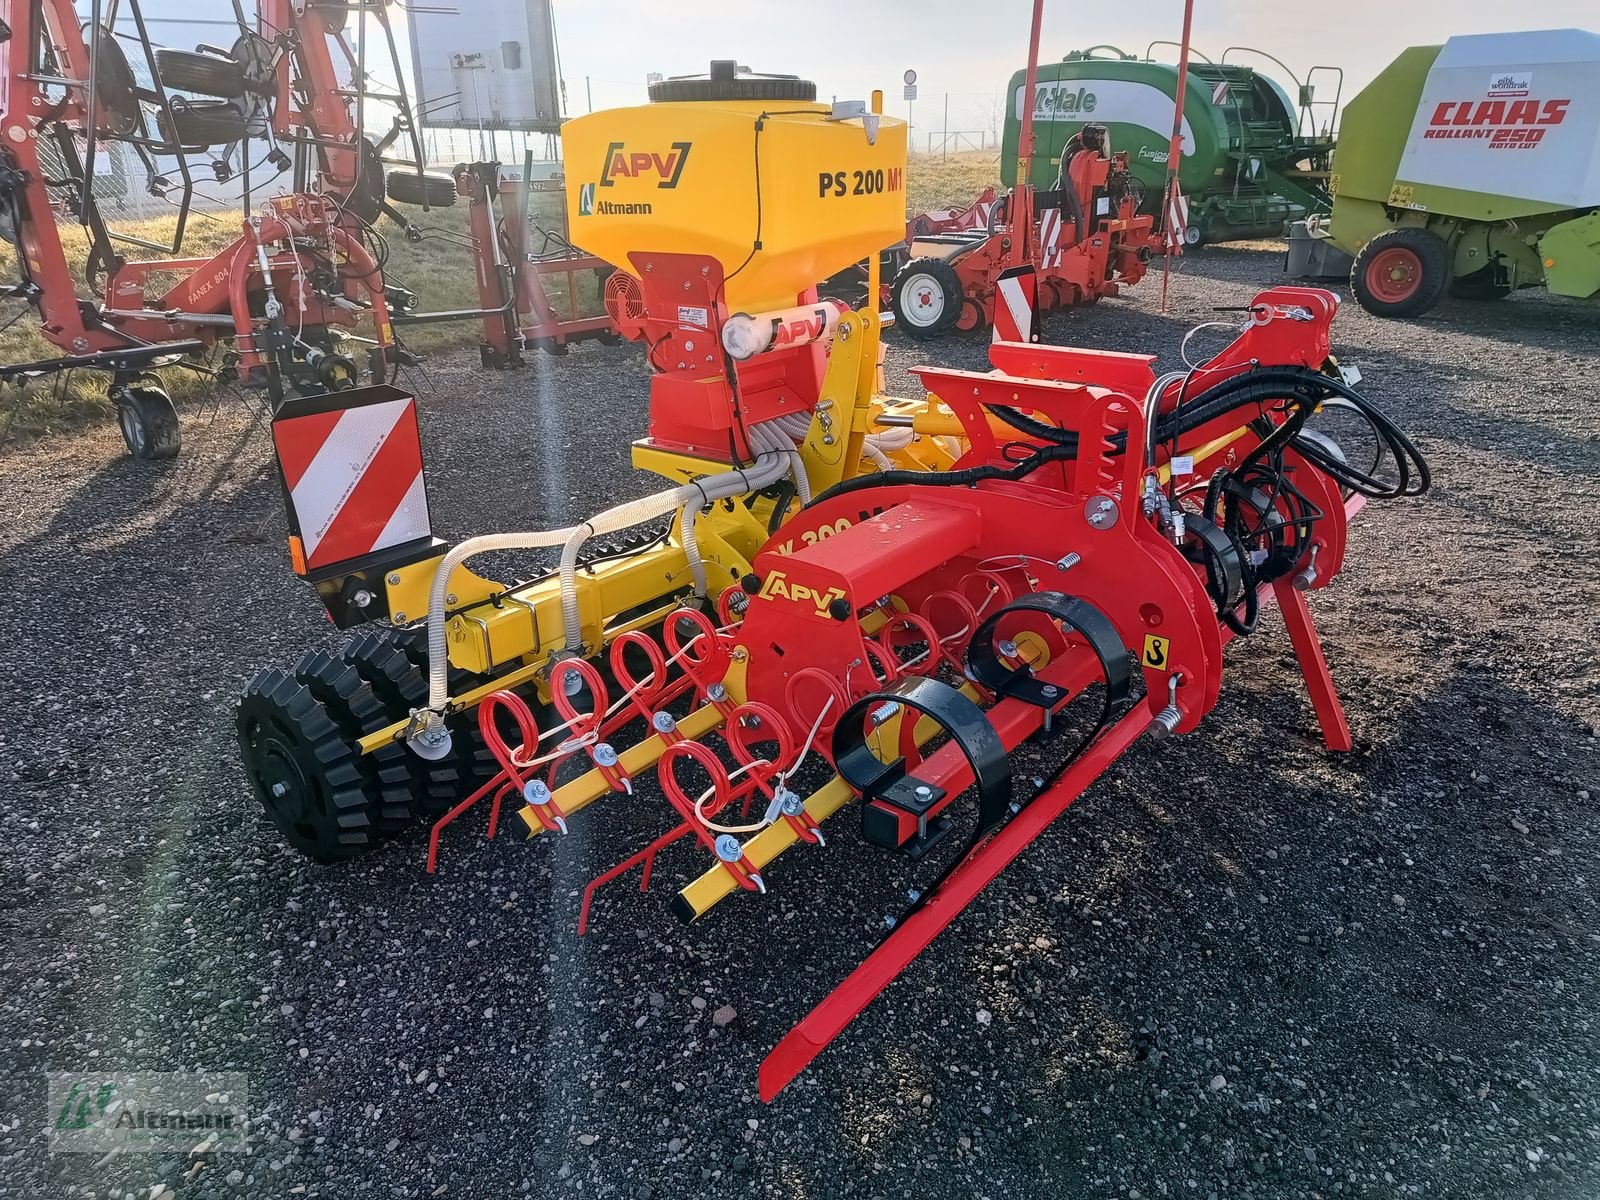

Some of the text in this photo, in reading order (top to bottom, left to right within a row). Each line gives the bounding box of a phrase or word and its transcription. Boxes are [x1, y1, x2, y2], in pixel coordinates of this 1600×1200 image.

[1430, 99, 1572, 126] CLAAS
[1424, 128, 1546, 143] ROLLANT 250
[819, 167, 902, 198] PS 200 M1
[596, 200, 653, 215] Altmann
[187, 267, 229, 305] FANEX 804
